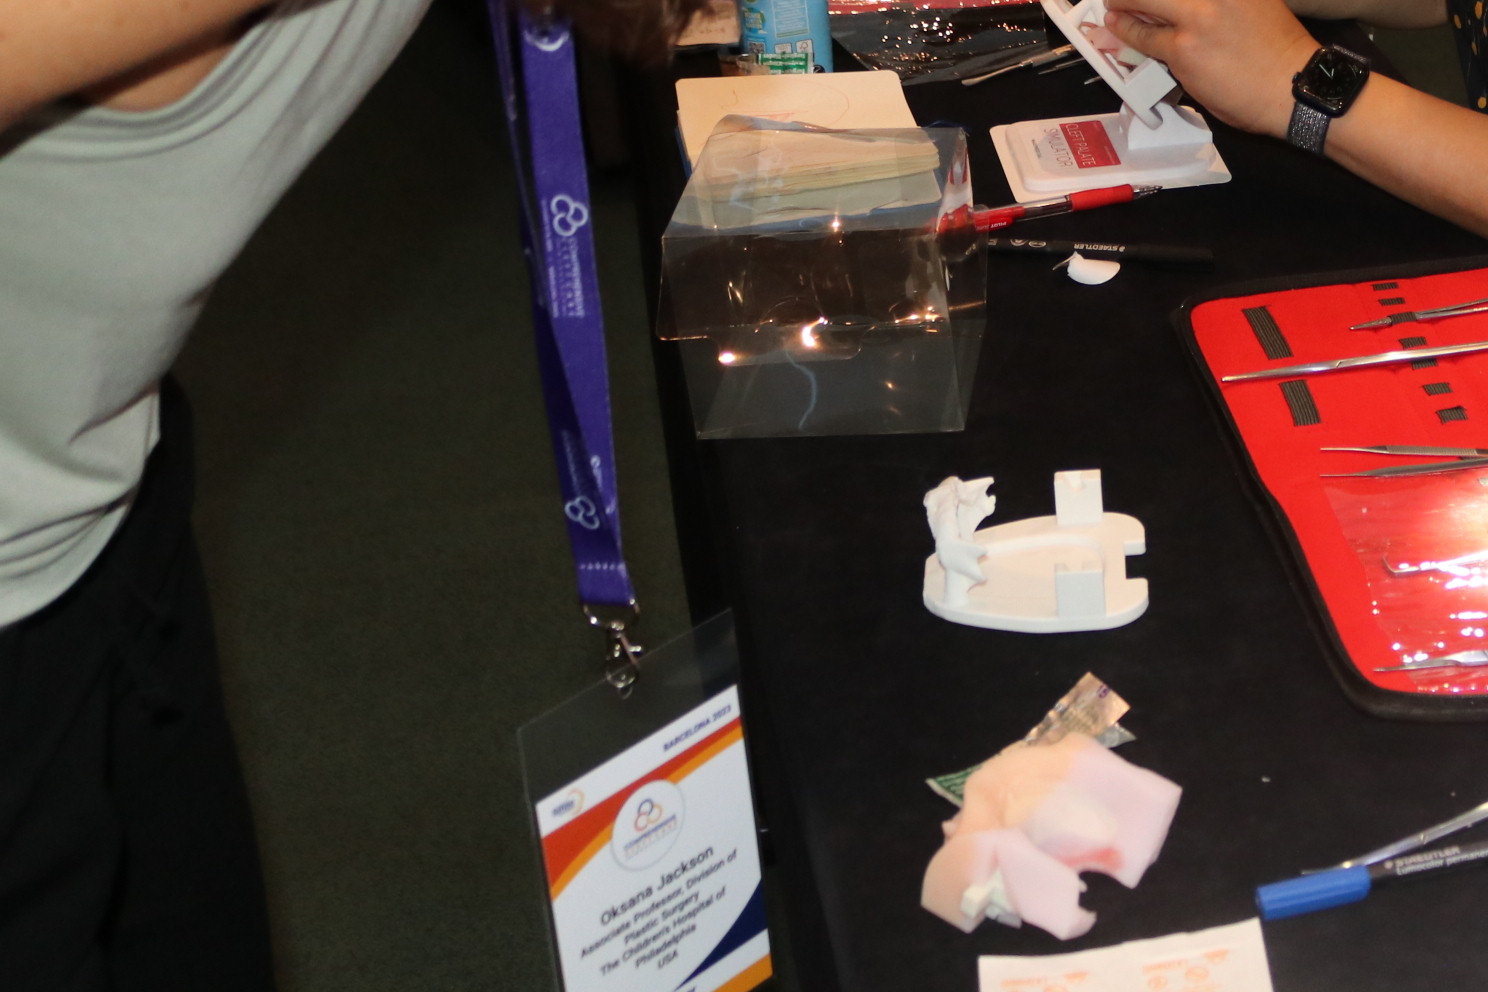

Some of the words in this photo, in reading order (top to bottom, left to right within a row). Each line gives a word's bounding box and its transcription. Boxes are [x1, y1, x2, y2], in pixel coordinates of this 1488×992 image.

[1044, 128, 1073, 166] SIMULATOR
[1065, 124, 1085, 142] CLEFT
[1078, 142, 1096, 166] PALATE
[990, 221, 1007, 229] PILOT
[1073, 243, 1118, 251] STAEDTLER
[1394, 846, 1460, 866] STAEDTLER
[581, 921, 631, 959] Associate
[633, 887, 685, 924] Professor,
[686, 860, 725, 890] Division
[727, 848, 737, 863] of
[601, 886, 653, 926] Oksana
[657, 847, 714, 890] Jackson
[601, 960, 620, 975] The
[622, 925, 670, 962] Children's
[672, 897, 713, 929] Hospital
[716, 886, 726, 901] of
[624, 917, 659, 944] Plastic
[661, 891, 700, 921] Surgery
[635, 924, 697, 969] Philadelphia
[657, 949, 679, 970] USA
